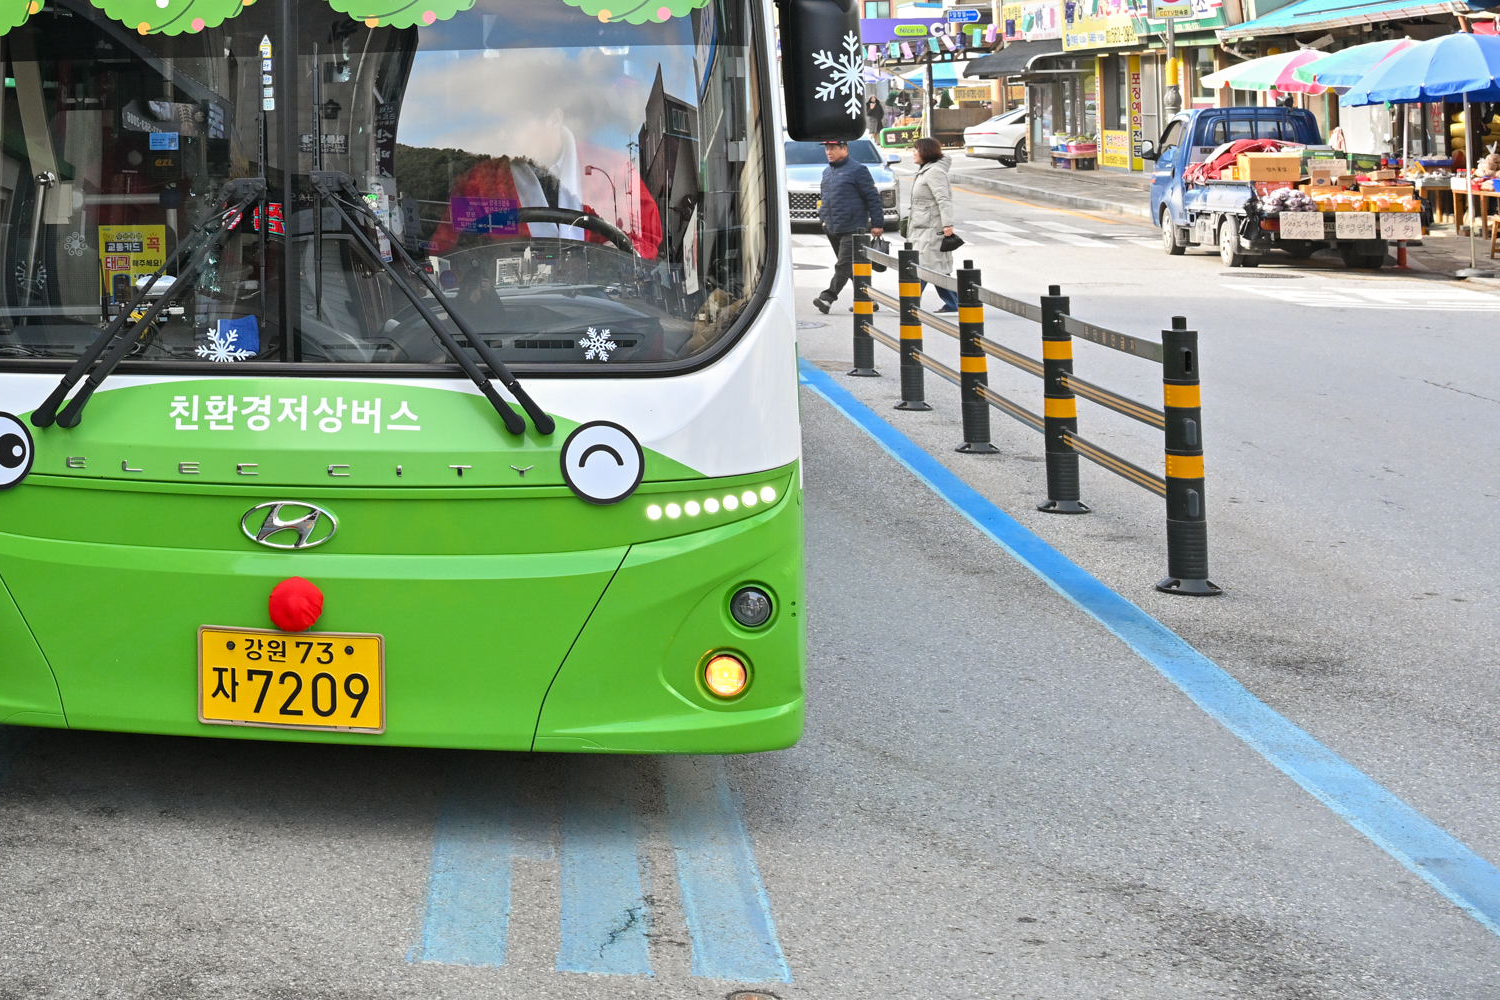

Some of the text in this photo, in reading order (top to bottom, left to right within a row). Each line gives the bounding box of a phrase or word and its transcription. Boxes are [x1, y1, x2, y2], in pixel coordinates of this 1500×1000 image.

[107, 237, 160, 252] 교통카드 꼭
[104, 256, 130, 270] 태그
[168, 394, 421, 433] 친환경저상버스
[244, 638, 334, 665] 강원 73
